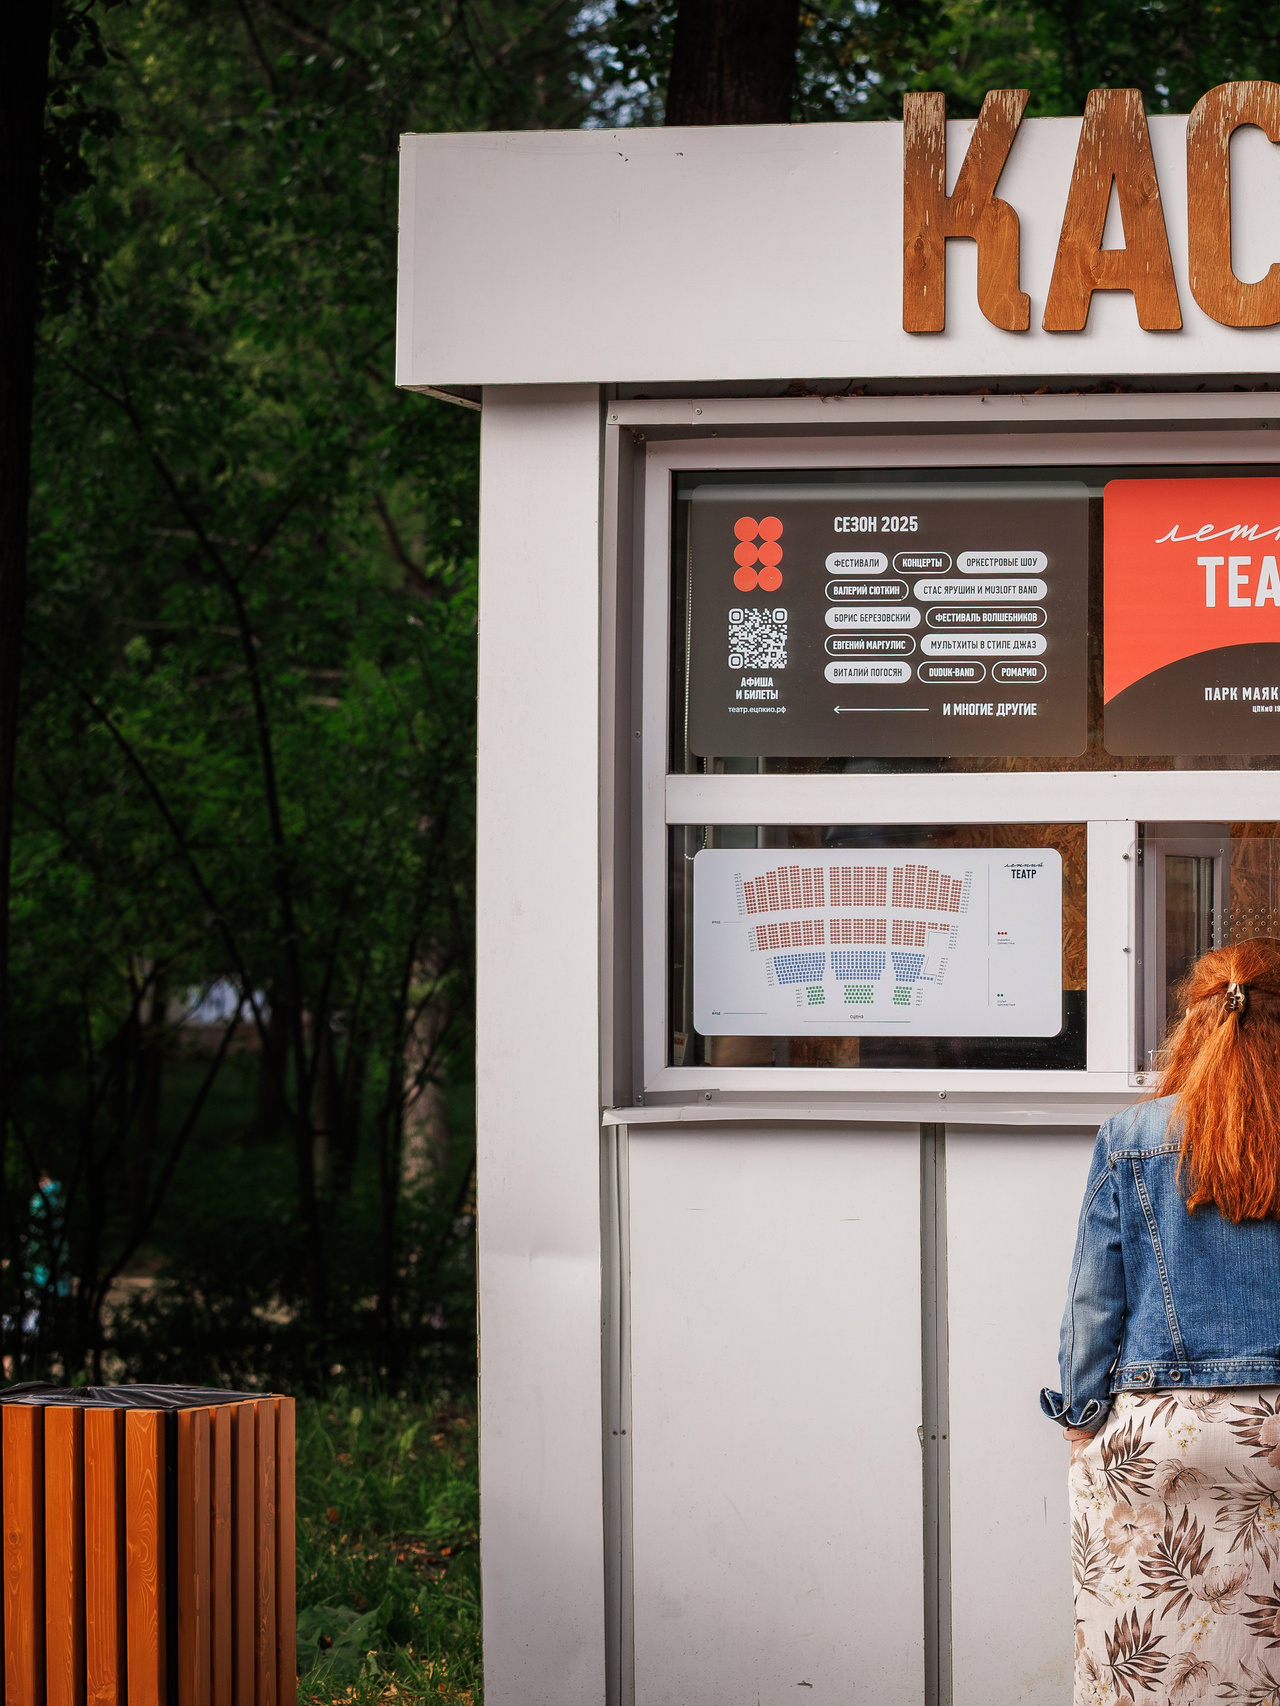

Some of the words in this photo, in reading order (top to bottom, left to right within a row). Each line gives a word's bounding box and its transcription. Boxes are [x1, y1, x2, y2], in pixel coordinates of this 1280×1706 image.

[834, 516, 877, 533] СЕЗОН
[881, 516, 918, 532] 2025
[834, 558, 880, 568] ФЕСТИВАЛИ
[902, 558, 943, 568] КОНЦЕРТЫ
[966, 557, 1018, 567] ОРКЕСТРОВЫЕ
[1020, 557, 1038, 567] ШОУ
[834, 584, 867, 595] ВАЛЕРИЙ
[869, 585, 900, 595] СЮТКИН
[923, 585, 941, 595] СТАС
[944, 585, 975, 595] ЯРУШИН
[977, 585, 982, 595] И
[985, 585, 1016, 595] MUЗLOFT
[1019, 585, 1037, 595] BAND
[834, 612, 858, 623] БОРИС
[860, 612, 911, 623] БЕРЕЗОВСКИЙ
[935, 613, 980, 623] ФЕСТИВАЛЬ
[982, 613, 1037, 623] ВОЛШЕБНИКОВ
[833, 639, 864, 650] ЕВГЕНИЙ
[866, 639, 906, 650] МАРГУЛИС
[931, 640, 978, 650] МУЛЬТХИТЫ
[980, 640, 985, 650] В
[987, 640, 1011, 650] СТИЛЕ
[1013, 640, 1037, 650] ДЖАЗ
[834, 667, 868, 678] ВИТАЛИЙ
[870, 667, 902, 678] ПОГОСЯН
[929, 667, 975, 677] DUDUK-BAND
[1001, 667, 1037, 677] РОМАРИО
[741, 677, 773, 687] АФИША
[736, 690, 742, 699] И
[744, 690, 778, 699] БИЛЕТЫ
[1205, 687, 1238, 701] ПАРК
[728, 706, 786, 714] театр.ецпкио.рф
[943, 704, 951, 716] И
[953, 704, 993, 716] МНОГИЕ
[996, 704, 1037, 717] ДРУГИЕ
[1011, 869, 1037, 879] ТЕАТР
